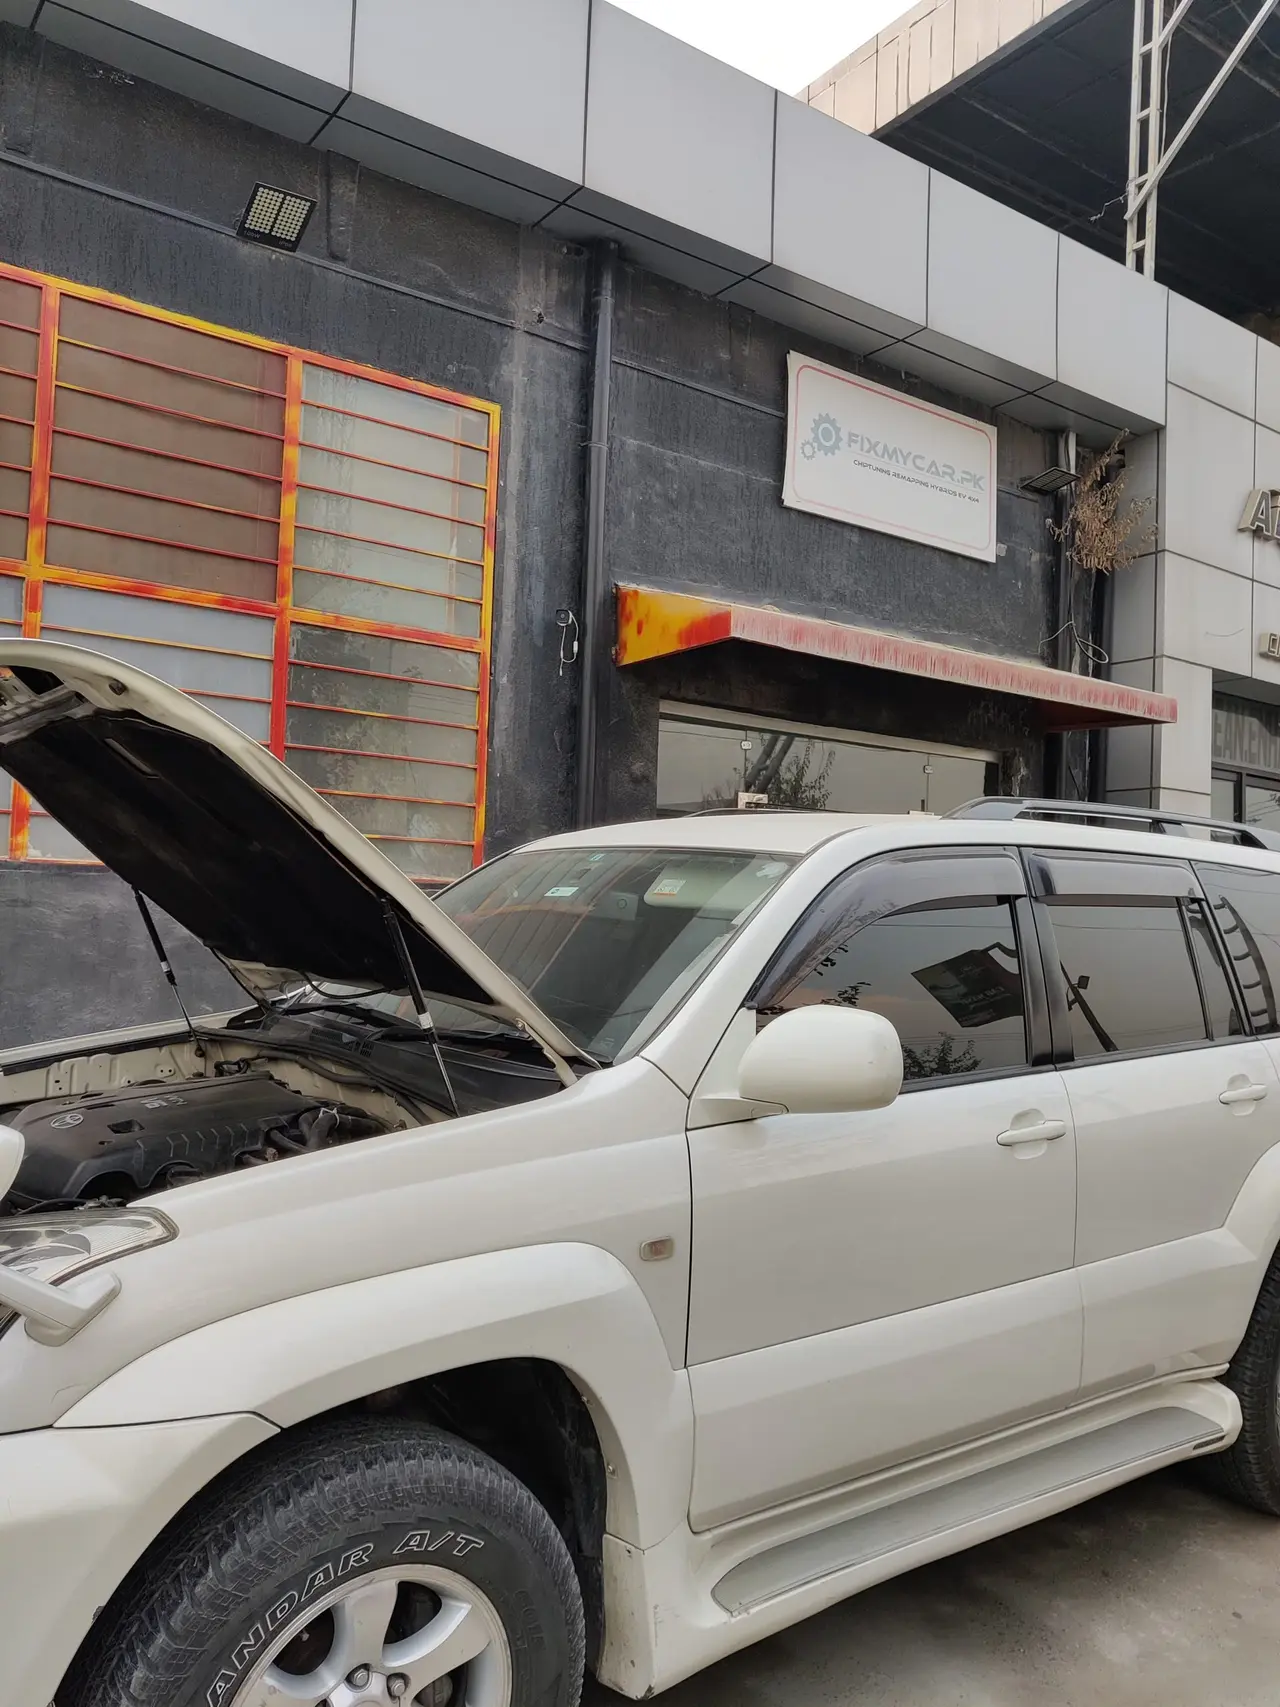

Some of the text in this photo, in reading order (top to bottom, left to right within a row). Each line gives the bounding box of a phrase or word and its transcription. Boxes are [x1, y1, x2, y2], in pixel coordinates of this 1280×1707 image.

[847, 431, 985, 491] FIXMYCAR.PK
[930, 484, 958, 498] HYBRIDS
[392, 1529, 485, 1556] A/T
